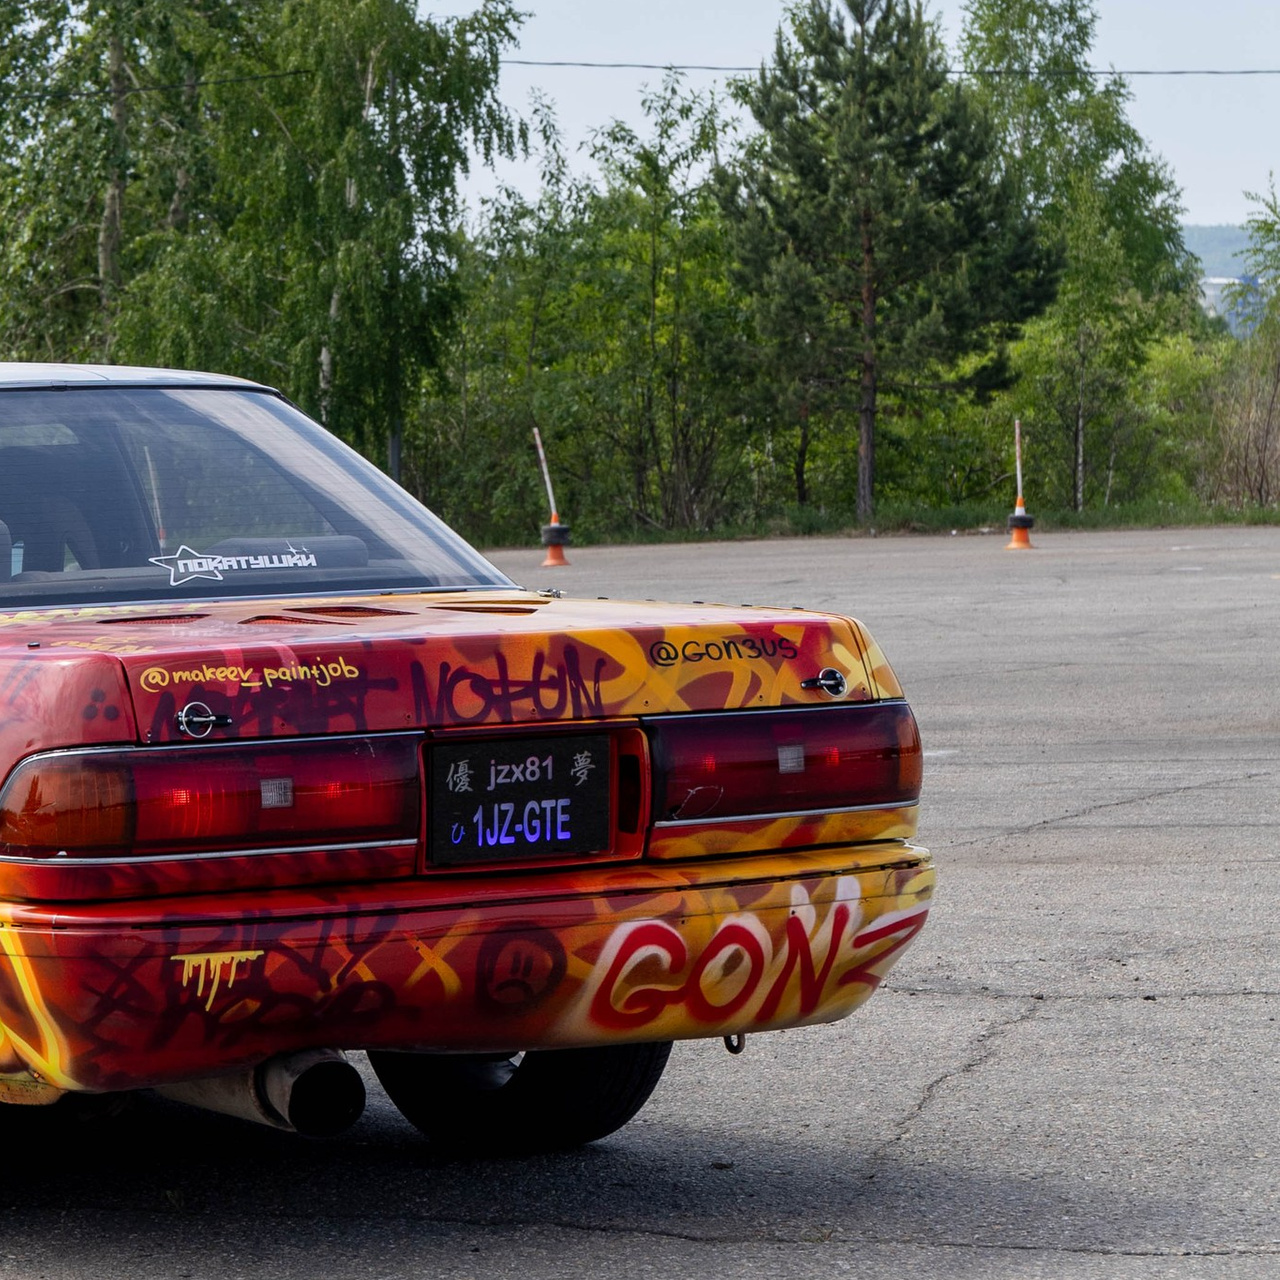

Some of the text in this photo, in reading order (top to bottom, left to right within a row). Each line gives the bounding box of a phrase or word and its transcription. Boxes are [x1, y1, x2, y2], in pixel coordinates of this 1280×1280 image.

[176, 554, 317, 573] ПОКАТУШКИ
[487, 755, 553, 791] jzx81
[570, 750, 596, 786] 夢
[473, 798, 571, 846] 1JZ-GTE
